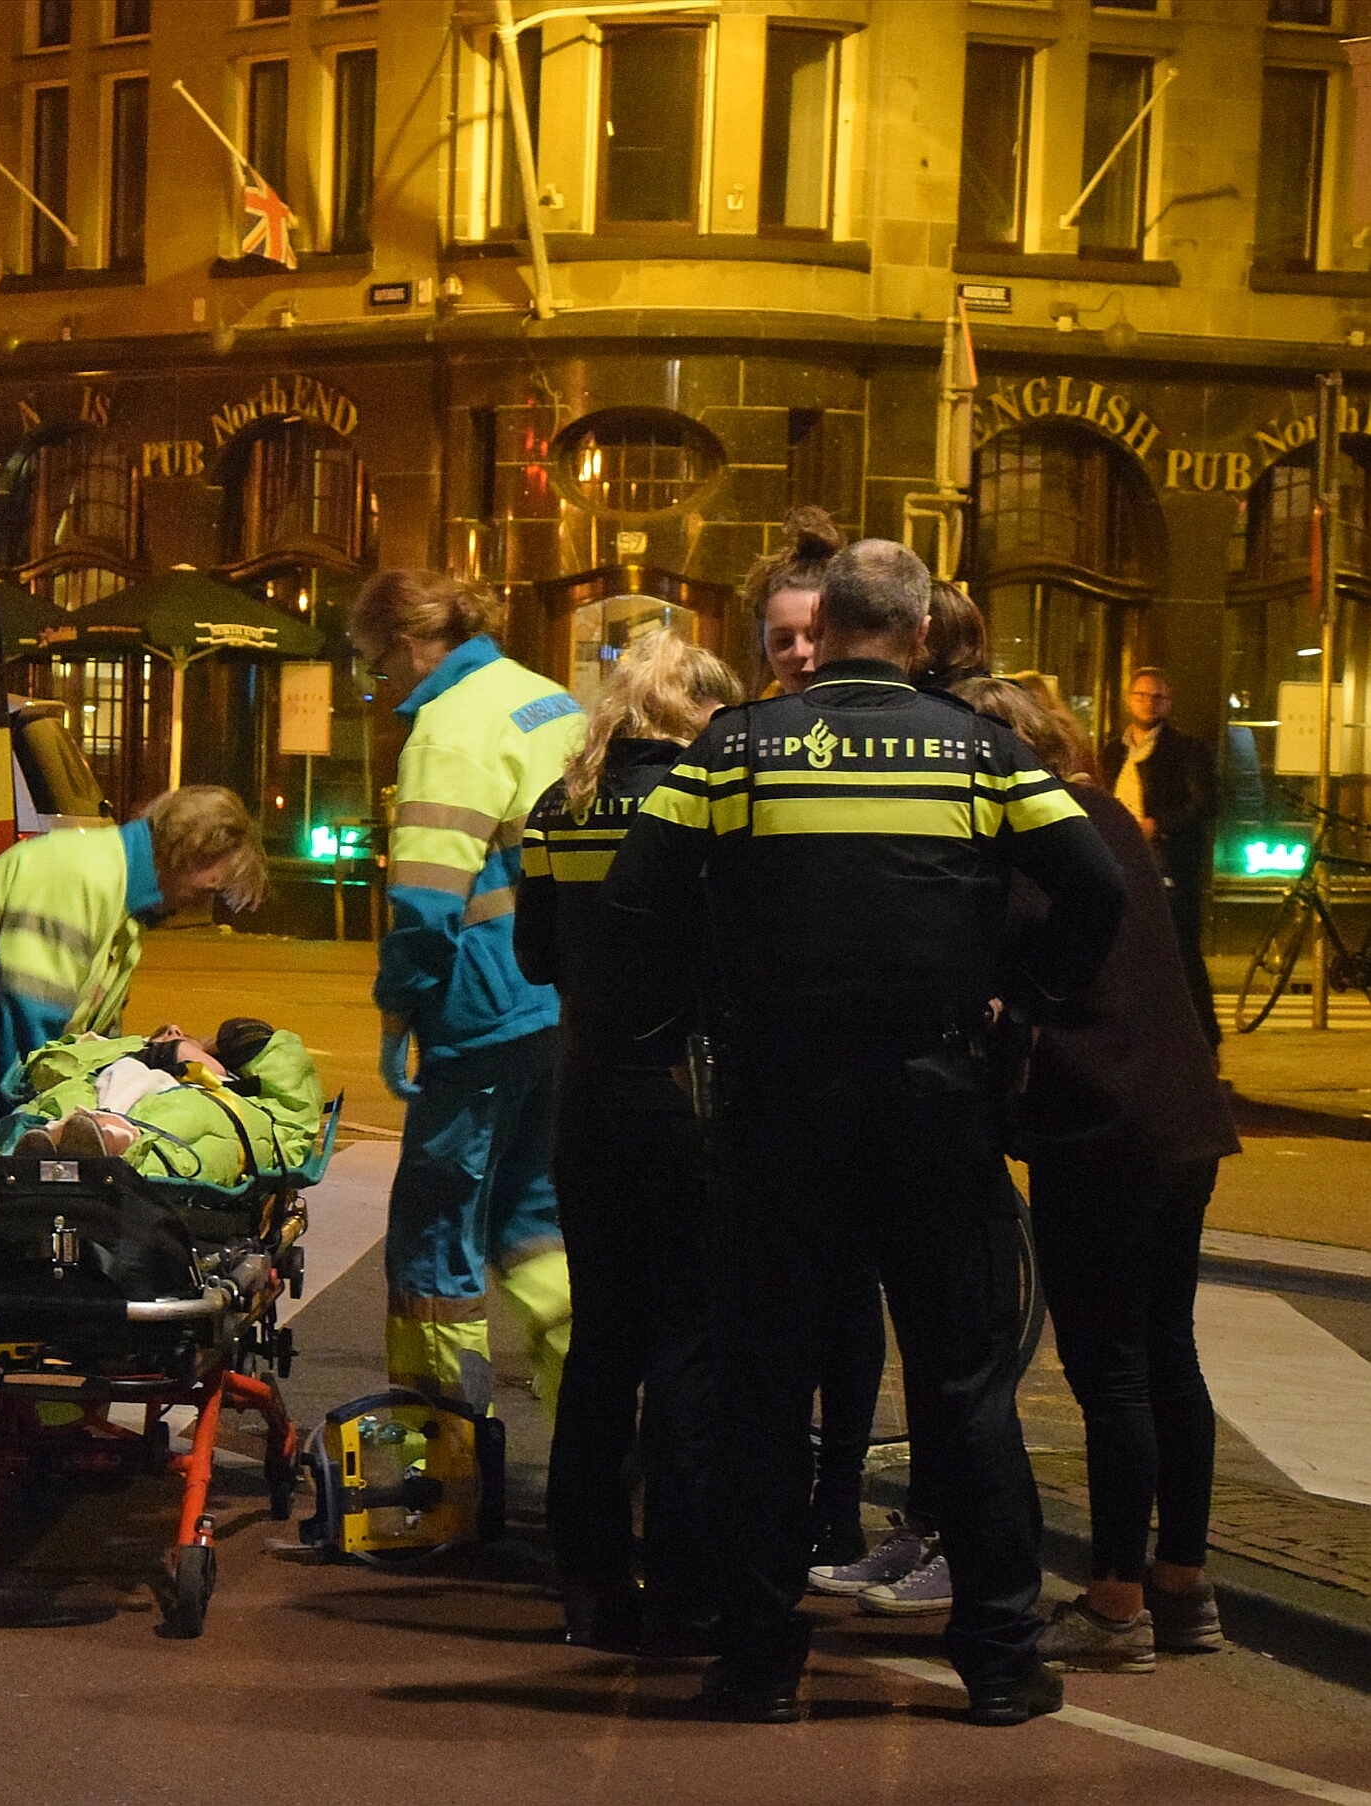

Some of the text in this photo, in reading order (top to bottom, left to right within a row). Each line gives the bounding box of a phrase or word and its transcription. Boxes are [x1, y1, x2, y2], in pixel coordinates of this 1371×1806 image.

[211, 375, 358, 448] North END
[1252, 395, 1359, 467] Norh
[142, 441, 204, 477] PUB
[1166, 449, 1251, 491] PUB
[784, 730, 940, 768] POLITIE
